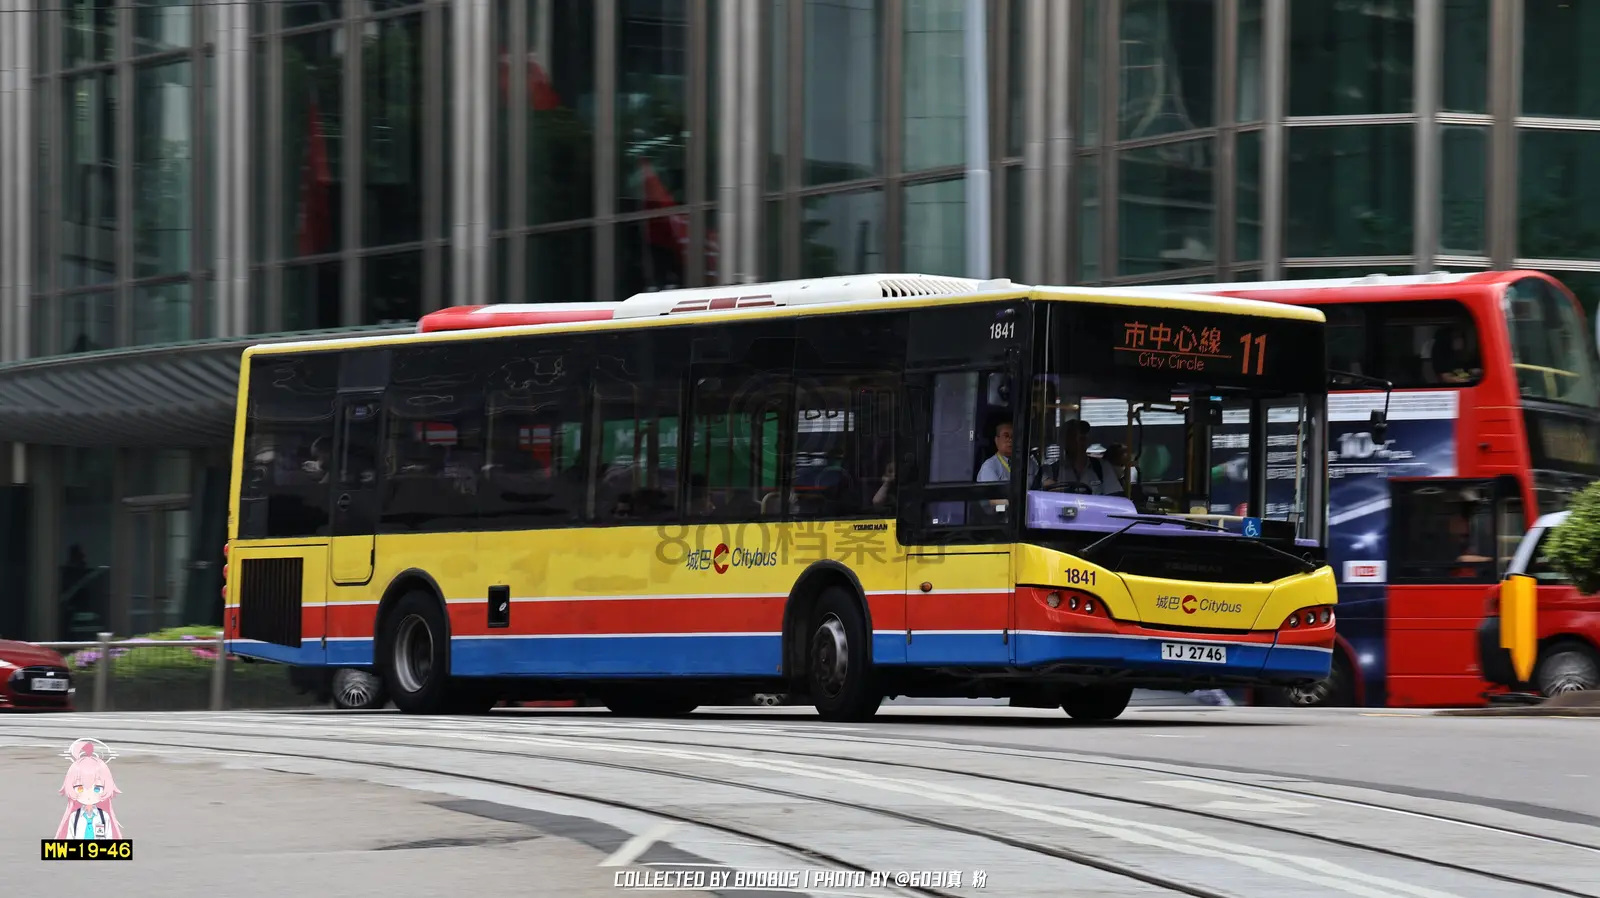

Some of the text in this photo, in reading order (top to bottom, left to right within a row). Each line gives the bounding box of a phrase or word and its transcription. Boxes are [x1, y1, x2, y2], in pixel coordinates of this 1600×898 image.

[990, 322, 1015, 339] 1841
[1124, 321, 1221, 354] 市中心線
[1138, 352, 1205, 371] City Circle
[1239, 332, 1268, 375] 11
[686, 549, 711, 570] 城巴
[732, 547, 777, 569] Citybus
[1064, 568, 1096, 586] 1841
[1156, 595, 1180, 610] 城巴
[1199, 598, 1242, 613] Citybus
[1166, 645, 1222, 661] TJ 2746
